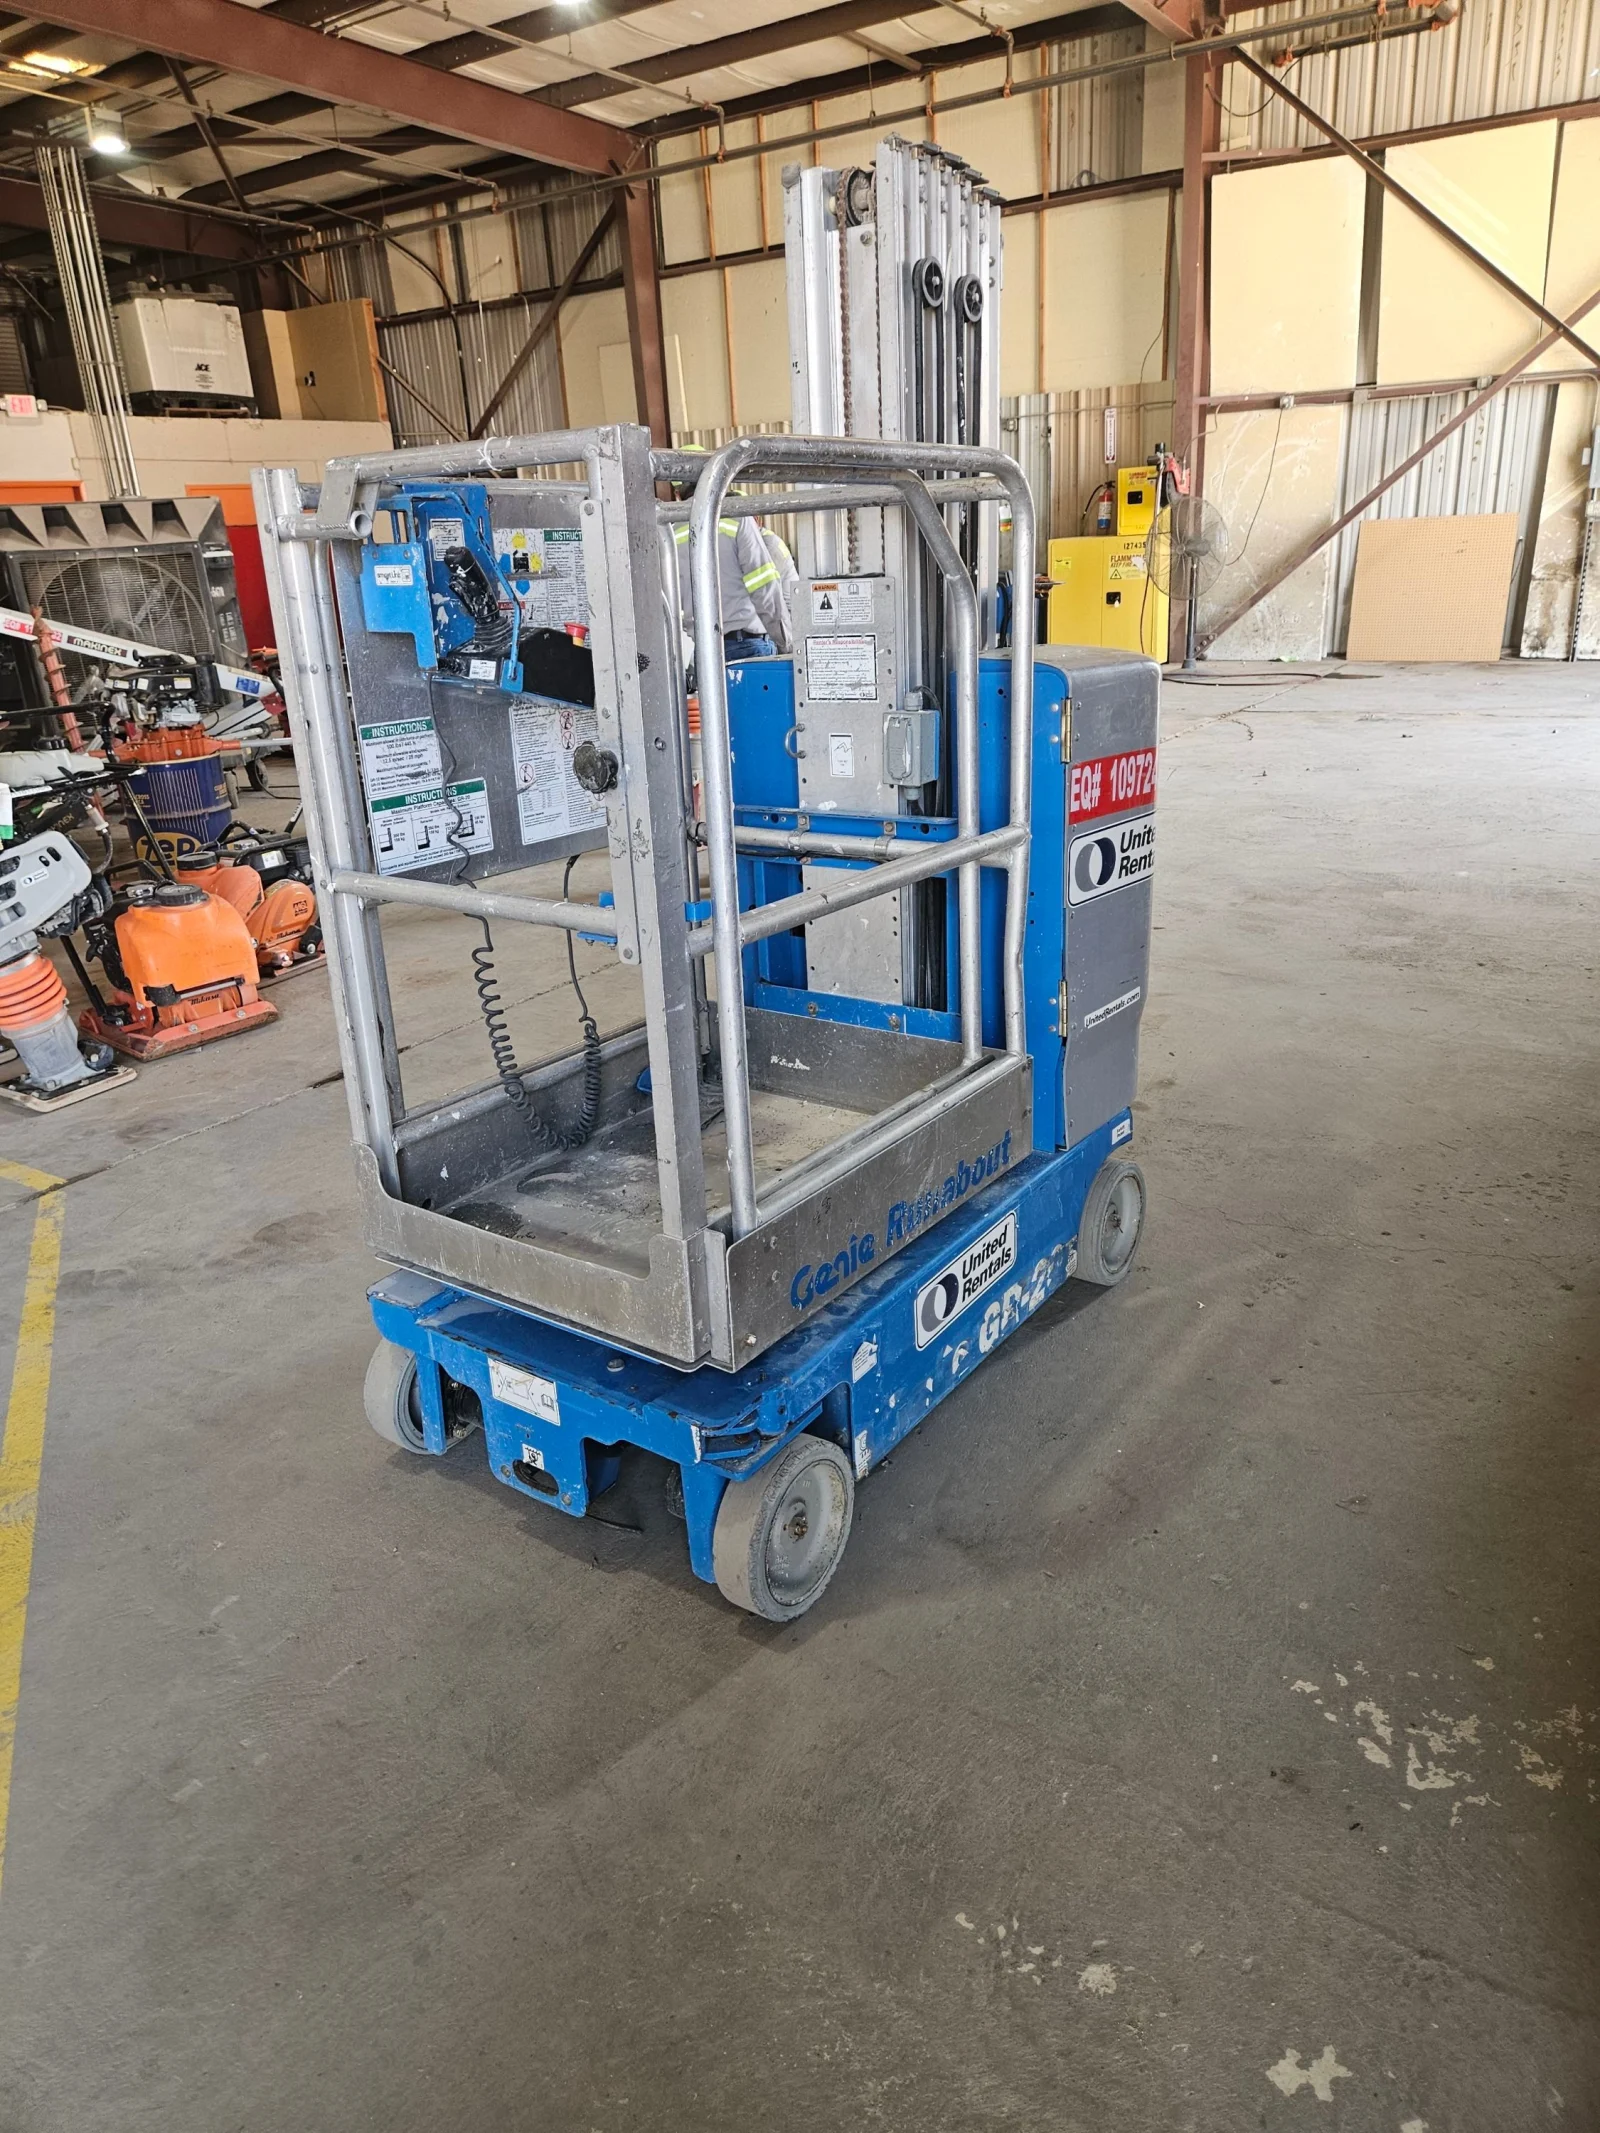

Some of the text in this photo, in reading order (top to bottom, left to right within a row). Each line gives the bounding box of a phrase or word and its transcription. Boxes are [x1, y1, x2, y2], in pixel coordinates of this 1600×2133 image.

[195, 363, 211, 372] ACE
[552, 531, 582, 540] INSTRUCT
[73, 637, 123, 656] MAKINEX
[372, 721, 428, 738] INSTRUCTIONS
[405, 787, 457, 804] INSTRUCTINS
[1070, 761, 1102, 812] EQ#
[1120, 824, 1156, 853] Unite
[1118, 851, 1155, 879] Rent
[790, 1129, 1012, 1310] Genie Runabout
[962, 1224, 1009, 1279] United
[962, 1246, 1012, 1303] Rentals
[979, 1244, 1063, 1354] GR-2
